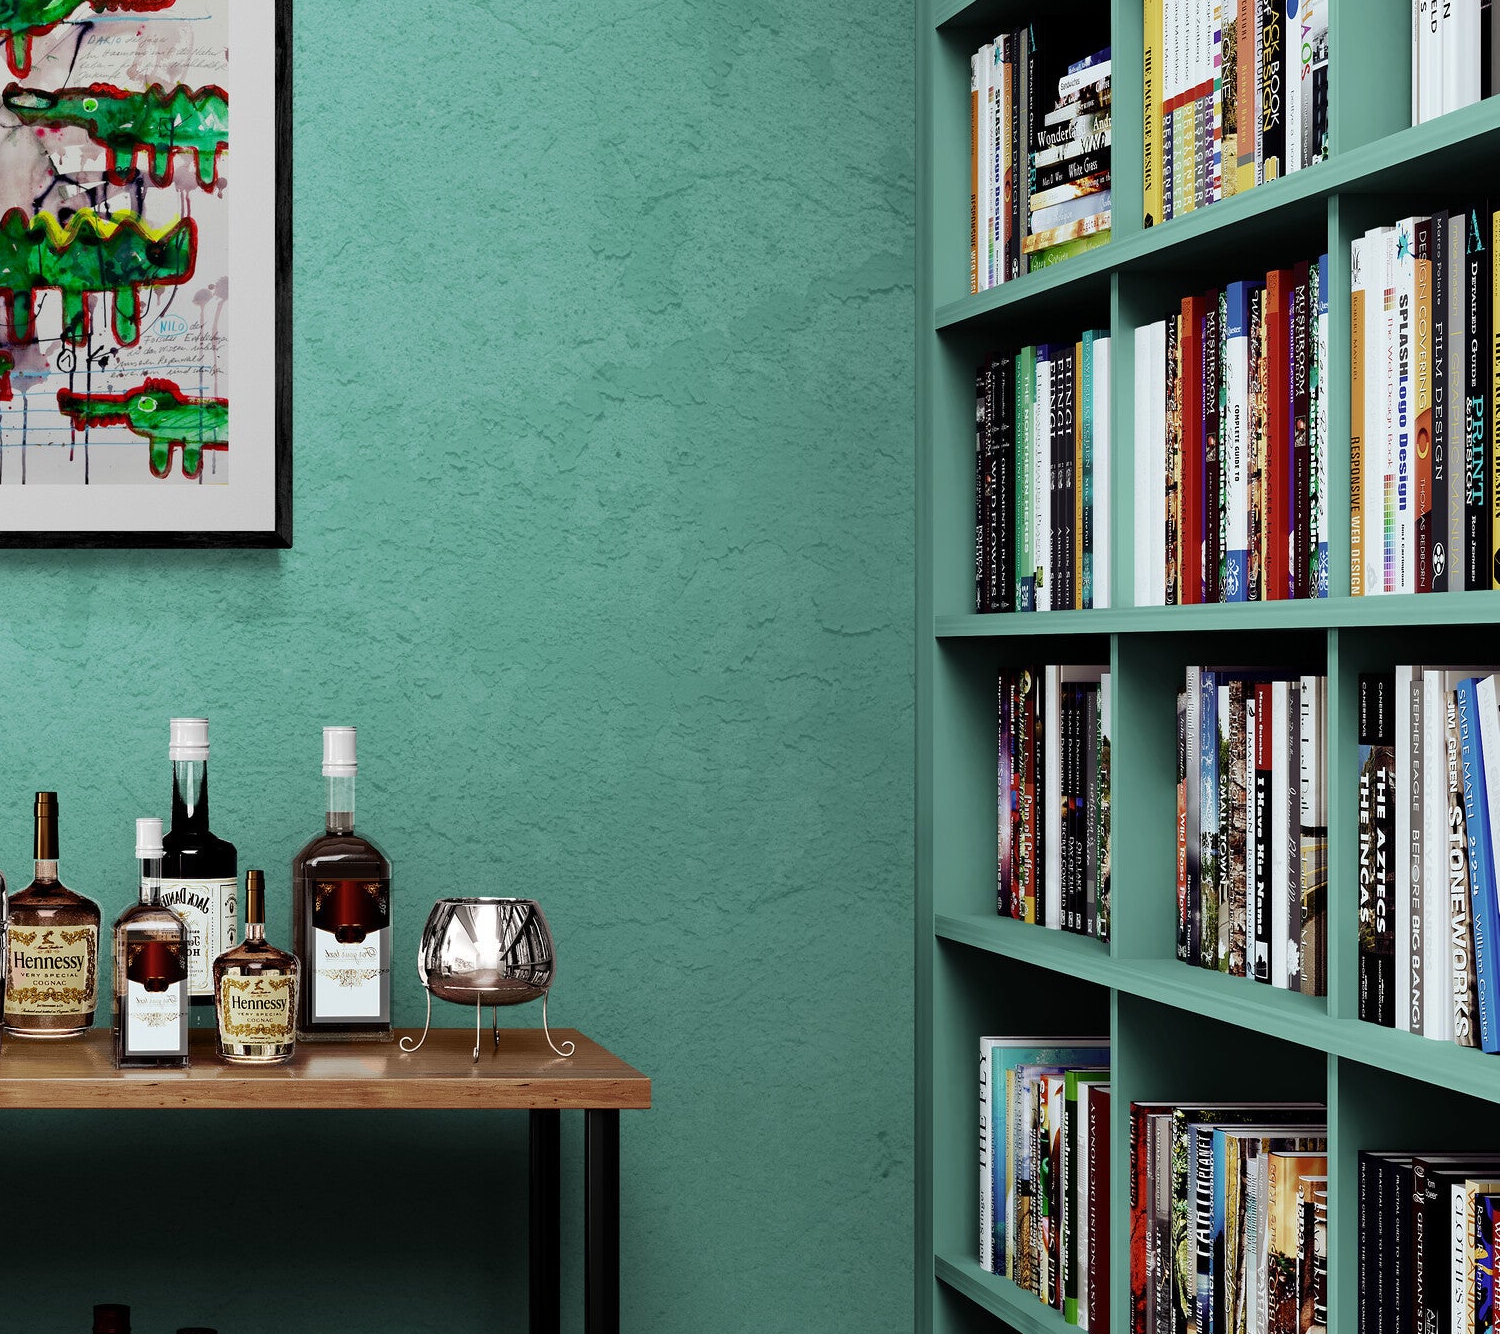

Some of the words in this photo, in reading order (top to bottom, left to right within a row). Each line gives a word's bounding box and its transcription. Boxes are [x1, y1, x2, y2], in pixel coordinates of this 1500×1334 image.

[88, 36, 122, 46] DARIO
[1271, 61, 1280, 127] BOOK
[1068, 162, 1083, 178] White
[1084, 156, 1098, 172] Grass
[1419, 230, 1427, 300] DESIGN
[1419, 306, 1427, 410] COVERING
[1235, 470, 1240, 482] TO
[1351, 436, 1360, 512] RESPONSIVE
[1472, 395, 1484, 506] PRINT
[1351, 516, 1360, 544] WEB
[1351, 549, 1360, 594] DESIGN
[1446, 702, 1457, 730] JIM
[1459, 689, 1470, 756] SIMPLE
[1447, 737, 1458, 794] GREEN
[1463, 762, 1475, 819] MATH
[1220, 775, 1228, 826] SMALL
[1257, 788, 1265, 838] Have
[1360, 773, 1369, 824] THE
[1376, 767, 1386, 819] THE
[1179, 812, 1187, 844] Wild
[1179, 848, 1187, 880] Rose
[1220, 832, 1228, 885] TOWN
[1257, 843, 1265, 876] His
[1360, 834, 1369, 923] INCAS
[1376, 828, 1386, 934] AZTECS
[1469, 836, 1480, 897] 2+2=4
[1179, 884, 1187, 932] Flower
[1257, 880, 1265, 935] Name
[1447, 806, 1470, 1037] STONEWORKS
[14, 951, 84, 972] Hennessy
[1474, 913, 1484, 974] William
[232, 995, 287, 1011] Hennessy
[1478, 979, 1489, 1043] Counter
[1467, 1189, 1476, 1247] WILD
